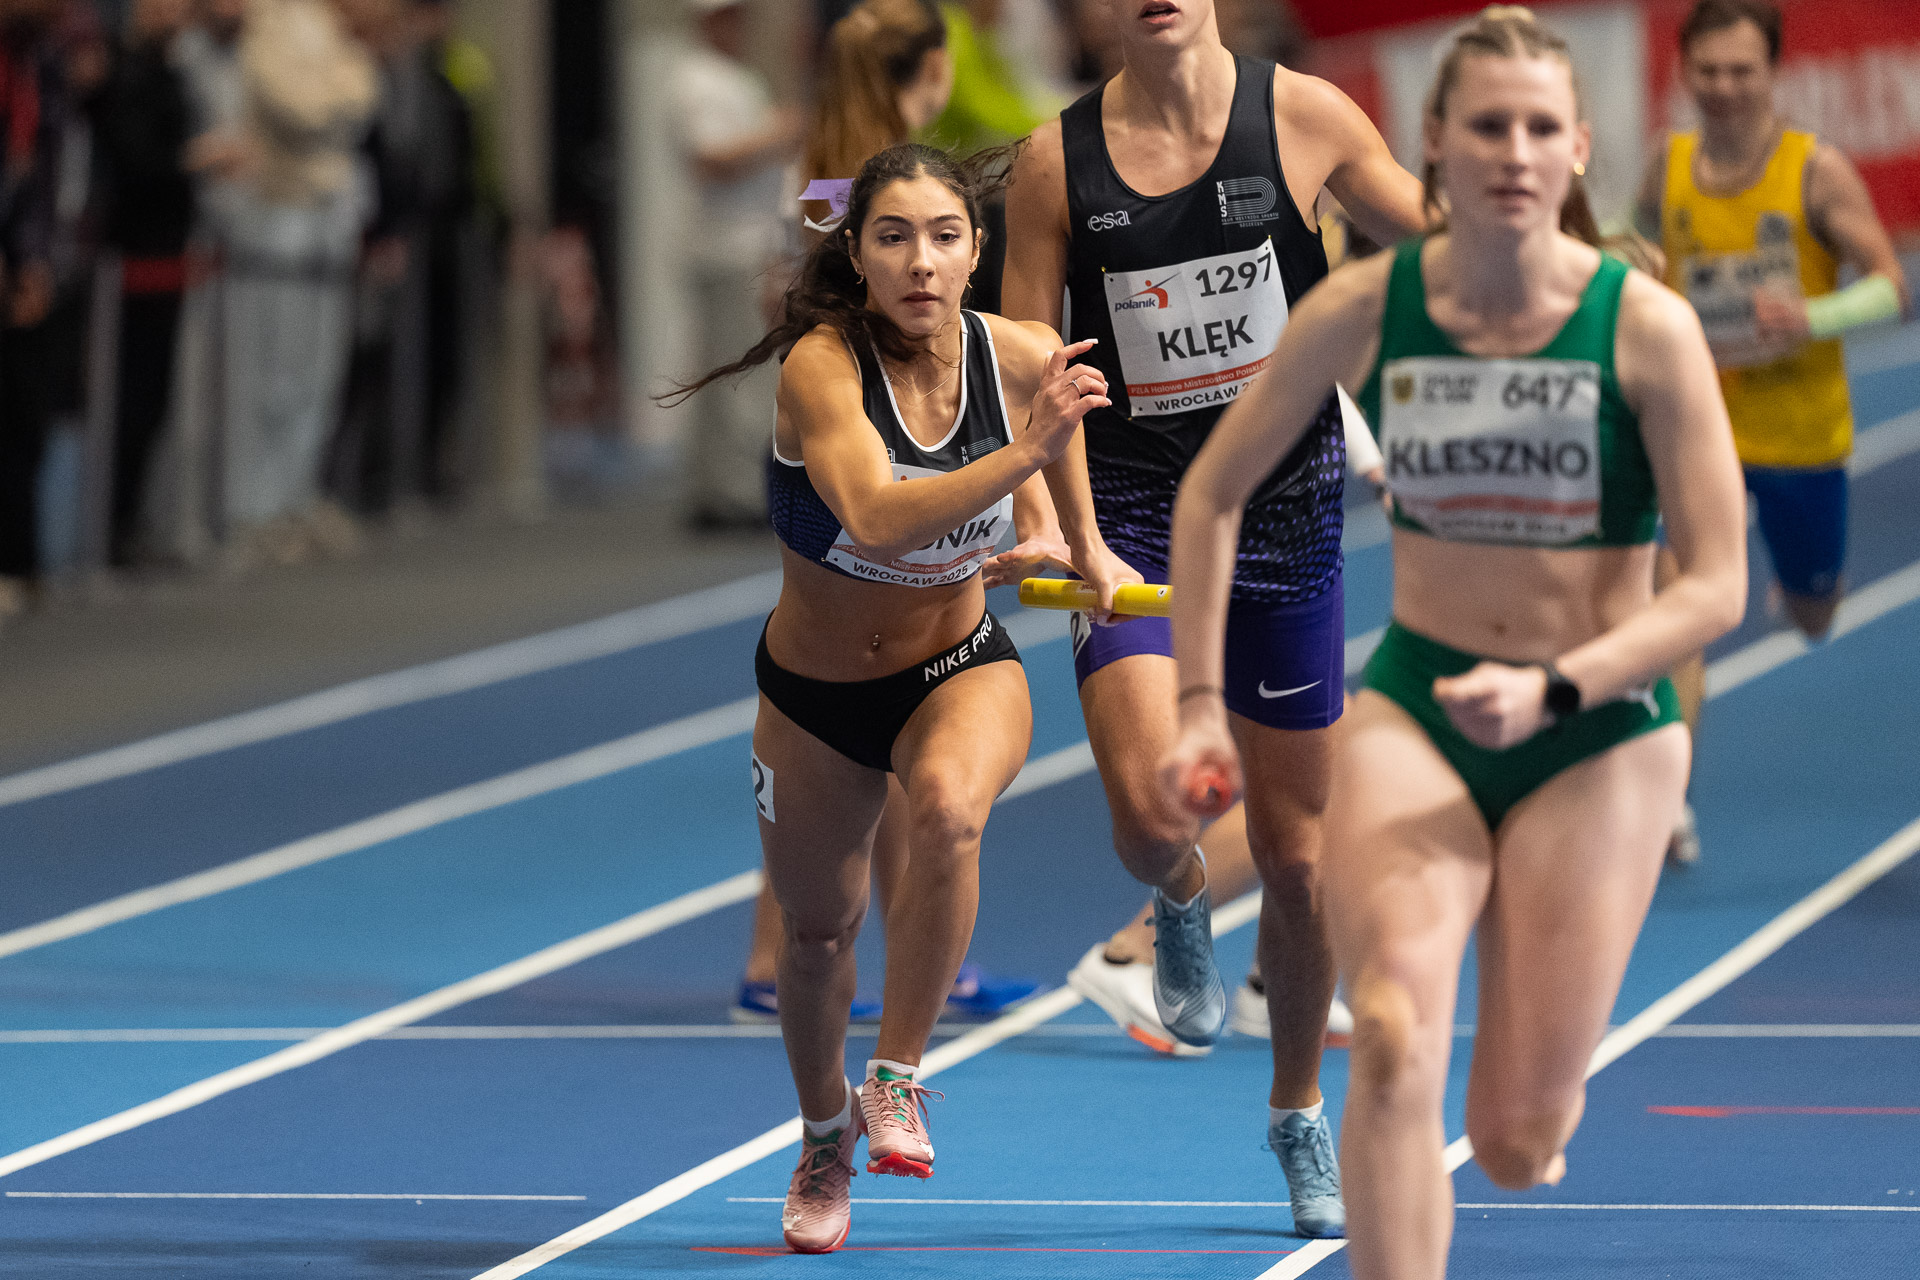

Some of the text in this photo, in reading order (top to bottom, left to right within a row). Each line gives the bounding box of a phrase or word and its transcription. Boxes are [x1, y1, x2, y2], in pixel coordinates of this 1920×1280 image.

[1195, 252, 1272, 298] 1297
[1114, 298, 1156, 312] polanik
[1157, 314, 1255, 362] KLĘK
[1131, 387, 1150, 395] PZLA
[1150, 383, 1182, 394] Halowe
[1183, 373, 1235, 389] Mistrzostwa
[1236, 364, 1260, 378] Polski
[1502, 371, 1577, 410] 647
[1154, 386, 1239, 411] WROCŁAW
[1388, 436, 1591, 480] KLESZNO
[917, 515, 1000, 551] NIK
[853, 561, 969, 586] WROCŁAW 2025
[924, 613, 992, 682] NIKE PRO
